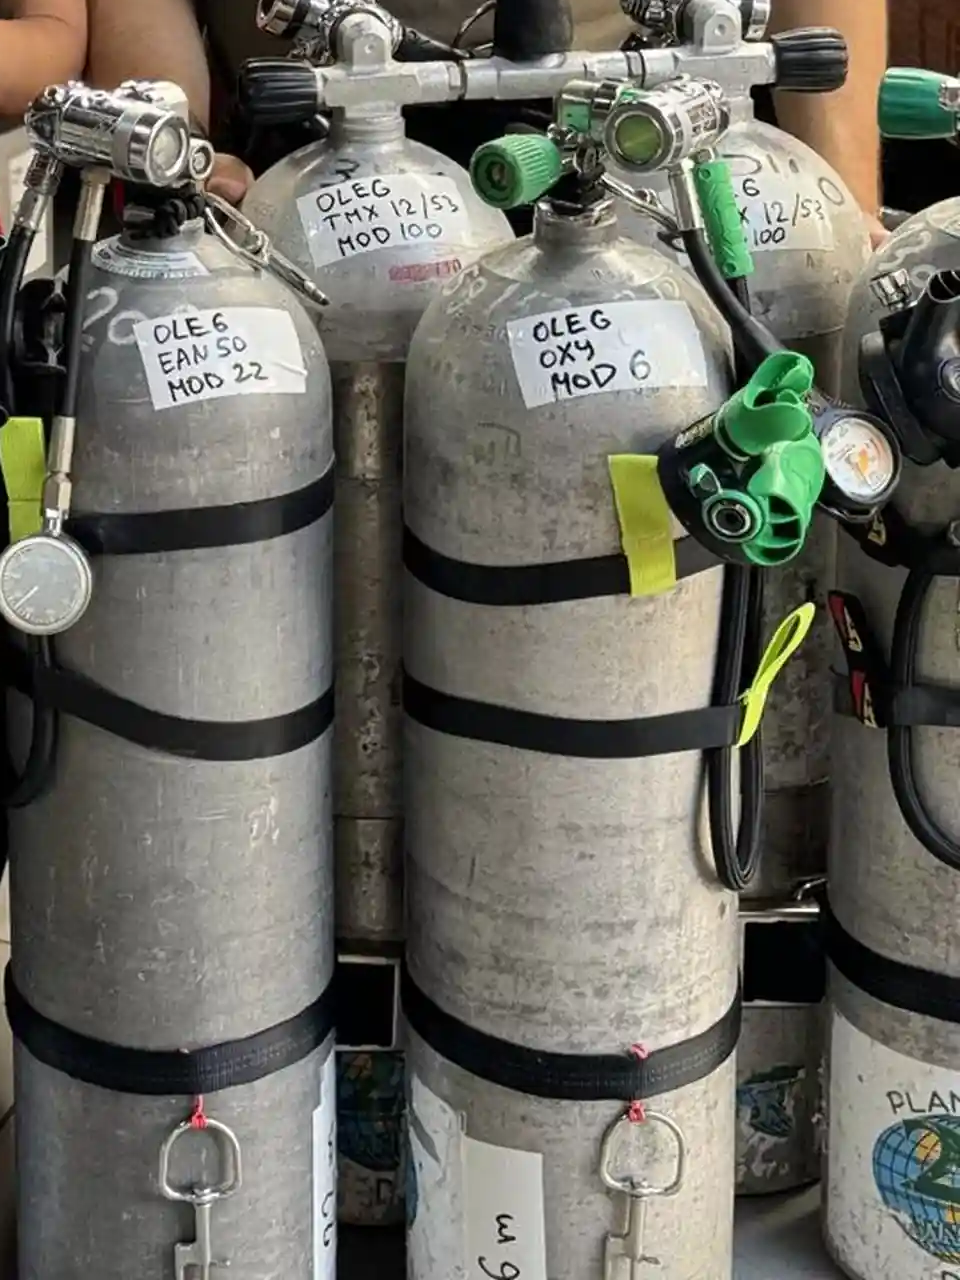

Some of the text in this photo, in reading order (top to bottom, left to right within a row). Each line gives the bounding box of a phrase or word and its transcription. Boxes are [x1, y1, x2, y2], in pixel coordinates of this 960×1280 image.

[316, 179, 390, 212] OLEG
[323, 204, 379, 230] TMX
[337, 223, 442, 256] MOD 100
[753, 227, 786, 246] 100
[153, 312, 229, 344] OLEG
[533, 310, 611, 342] OLEG
[158, 336, 247, 374] EAN 50
[539, 339, 595, 369] OXY
[167, 362, 268, 402] MOD 22
[550, 350, 651, 395] MOD 6
